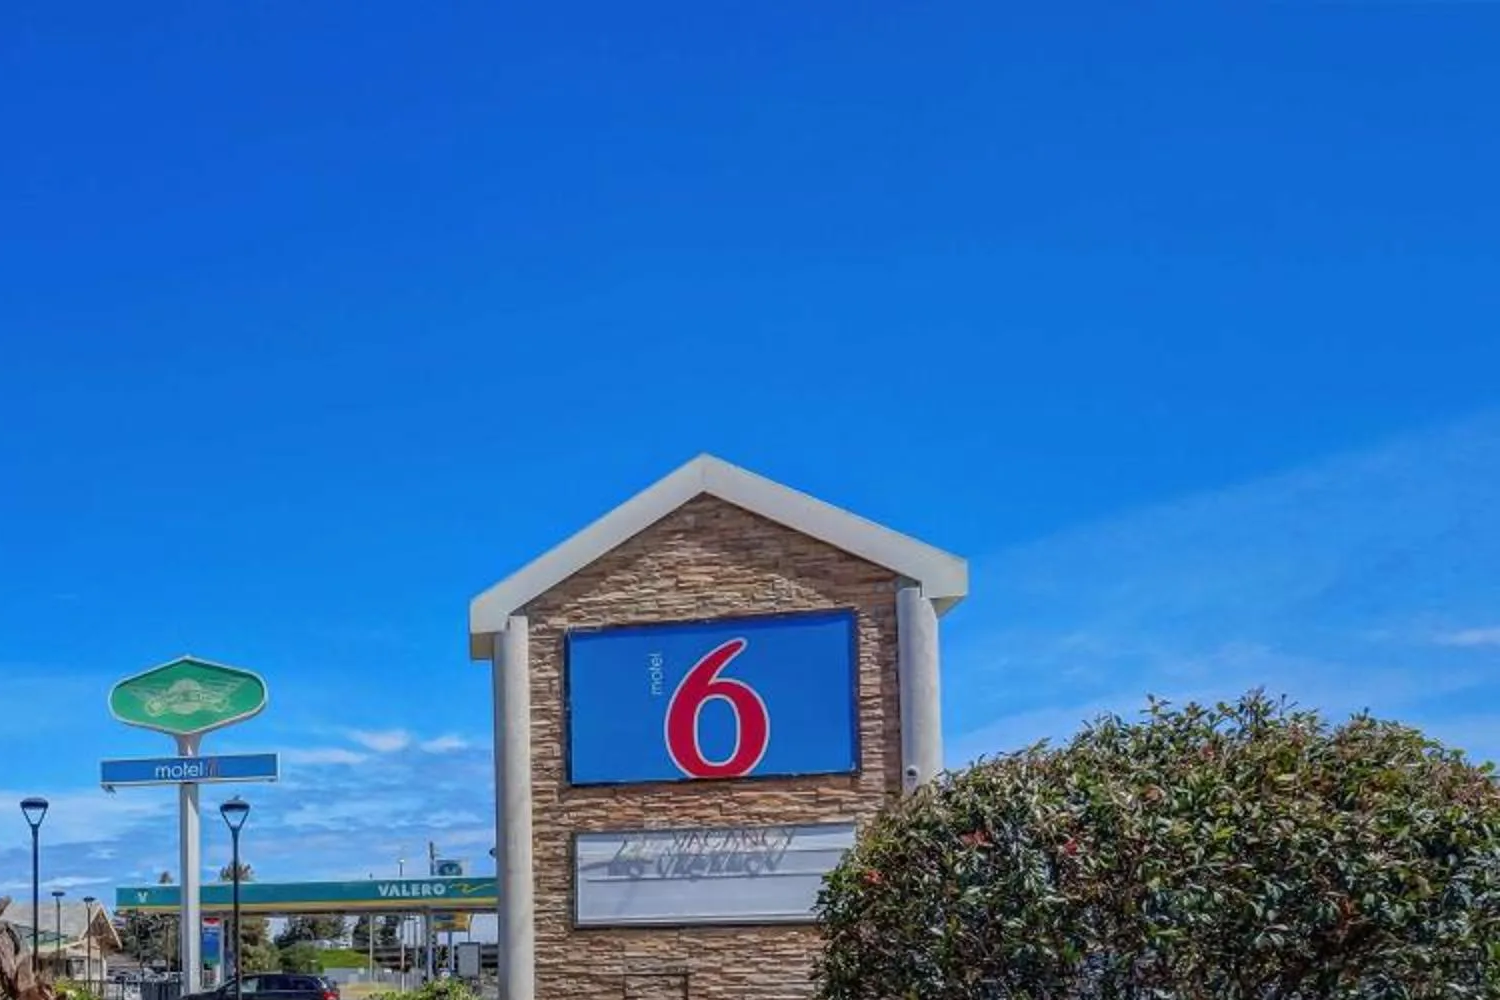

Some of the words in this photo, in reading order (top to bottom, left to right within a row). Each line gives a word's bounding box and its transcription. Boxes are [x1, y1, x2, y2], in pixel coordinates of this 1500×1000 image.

[649, 653, 663, 695] motel
[664, 637, 770, 778] 6
[155, 761, 204, 779] motel
[672, 827, 796, 849] VACANCY
[378, 883, 446, 897] VALERO
